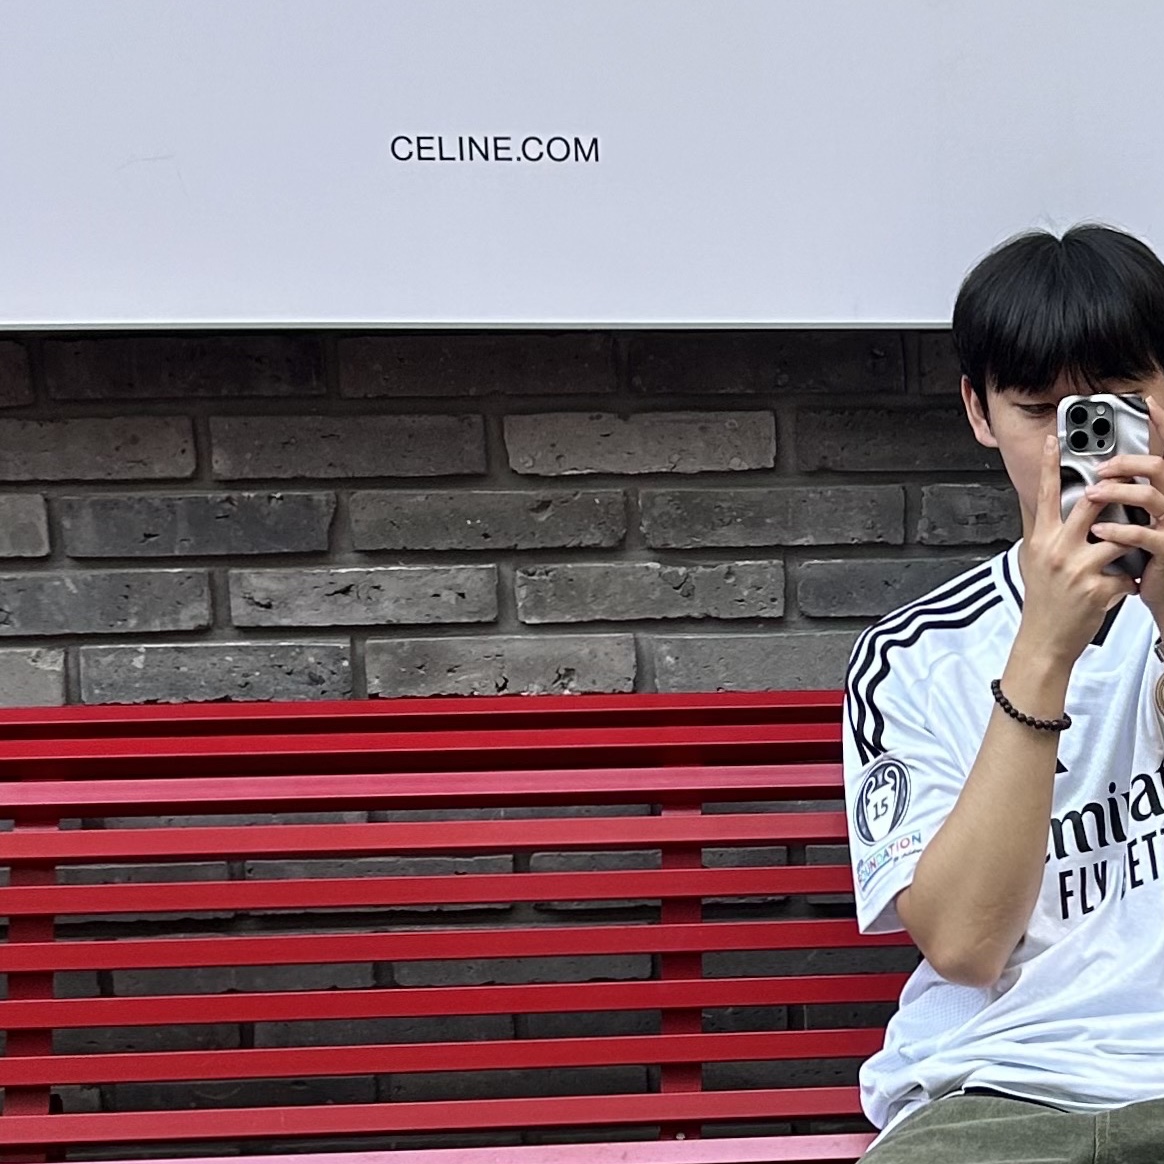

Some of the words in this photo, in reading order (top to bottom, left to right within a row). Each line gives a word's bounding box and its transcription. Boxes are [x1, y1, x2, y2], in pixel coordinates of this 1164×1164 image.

[390, 135, 600, 162] CELINE.COM
[872, 796, 889, 822] 15
[1058, 859, 1108, 920] FLY
